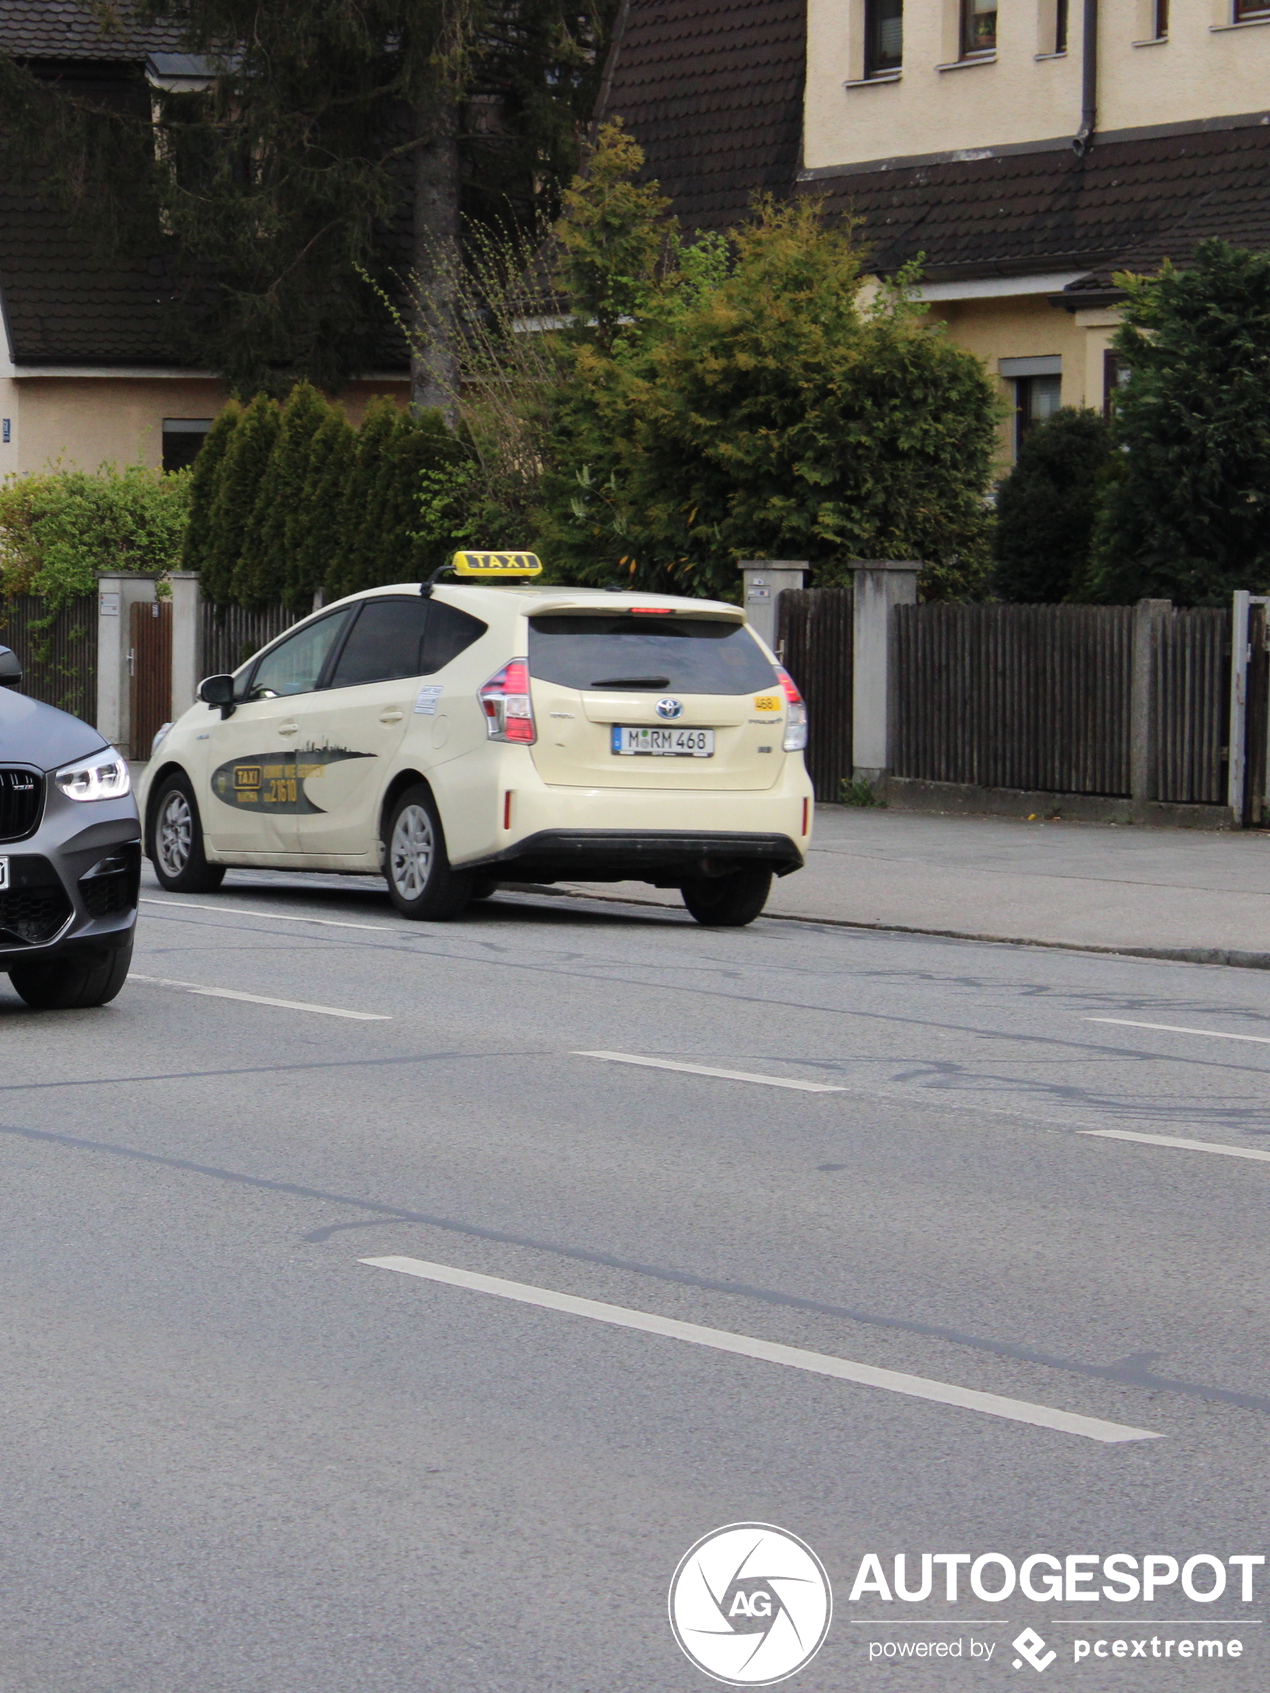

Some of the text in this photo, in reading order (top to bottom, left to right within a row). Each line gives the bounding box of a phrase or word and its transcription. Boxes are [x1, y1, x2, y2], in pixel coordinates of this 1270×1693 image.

[472, 555, 530, 568] TAXI
[755, 698, 773, 710] 468
[628, 730, 706, 749] M RM 468
[237, 771, 258, 784] TAXI
